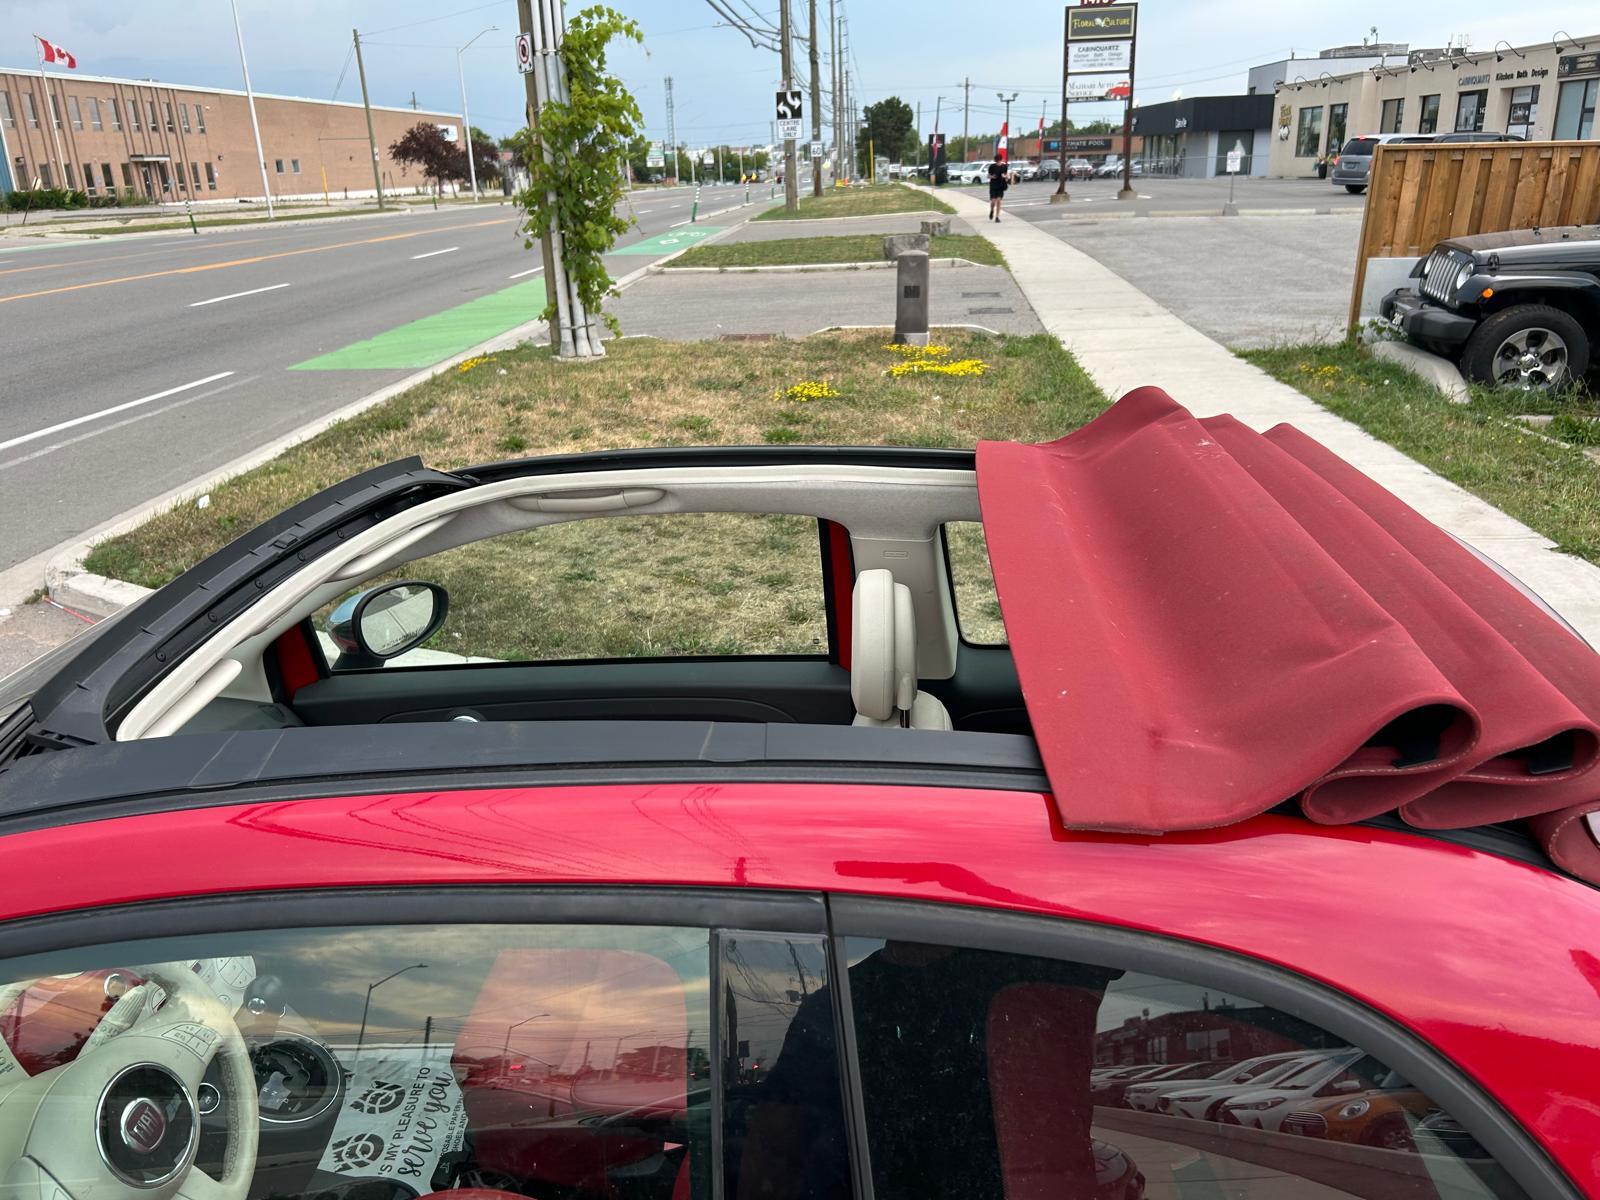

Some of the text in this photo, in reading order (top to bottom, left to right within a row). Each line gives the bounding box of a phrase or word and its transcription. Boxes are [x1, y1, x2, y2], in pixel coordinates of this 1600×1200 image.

[1103, 17, 1130, 27] CULTURE
[1495, 72, 1514, 81] Kitchen
[1516, 70, 1528, 79] Bath
[1531, 67, 1549, 79] Design
[132, 1106, 158, 1141] FIAT
[384, 1142, 400, 1161] MY
[393, 1082, 425, 1139] PLEASURE
[417, 1067, 431, 1081] TO
[397, 1071, 454, 1177] serve you
